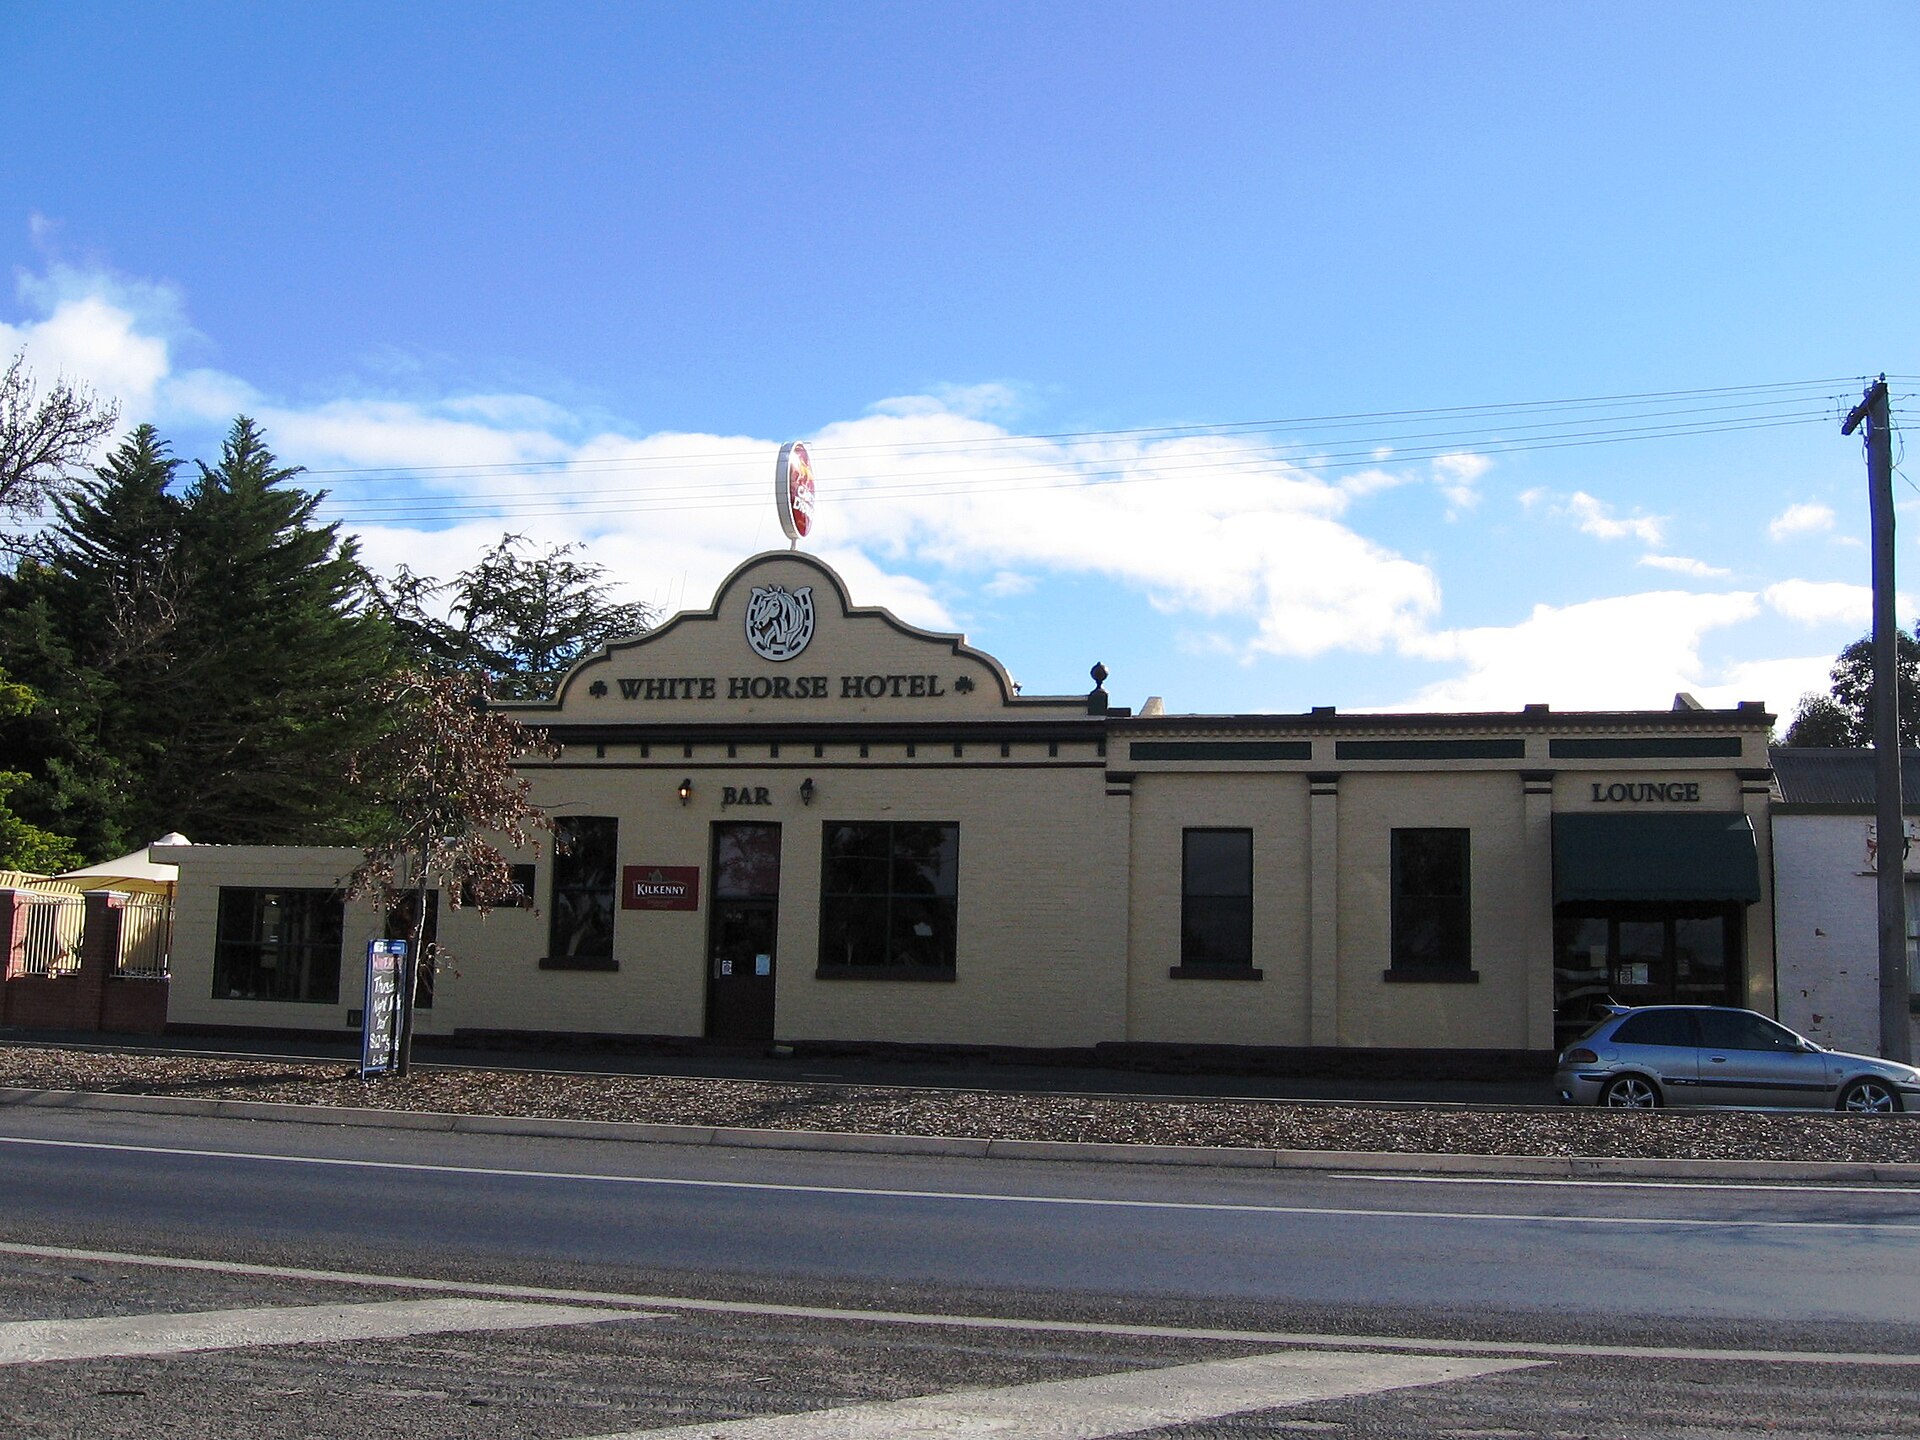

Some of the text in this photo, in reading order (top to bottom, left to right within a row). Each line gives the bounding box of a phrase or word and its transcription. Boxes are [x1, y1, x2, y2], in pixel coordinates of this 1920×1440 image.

[617, 675, 945, 700] WHITE HORSE HOTEL
[722, 786, 771, 806] BAR
[1591, 782, 1701, 802] LOUNGE
[637, 883, 685, 896] KILKENNY
